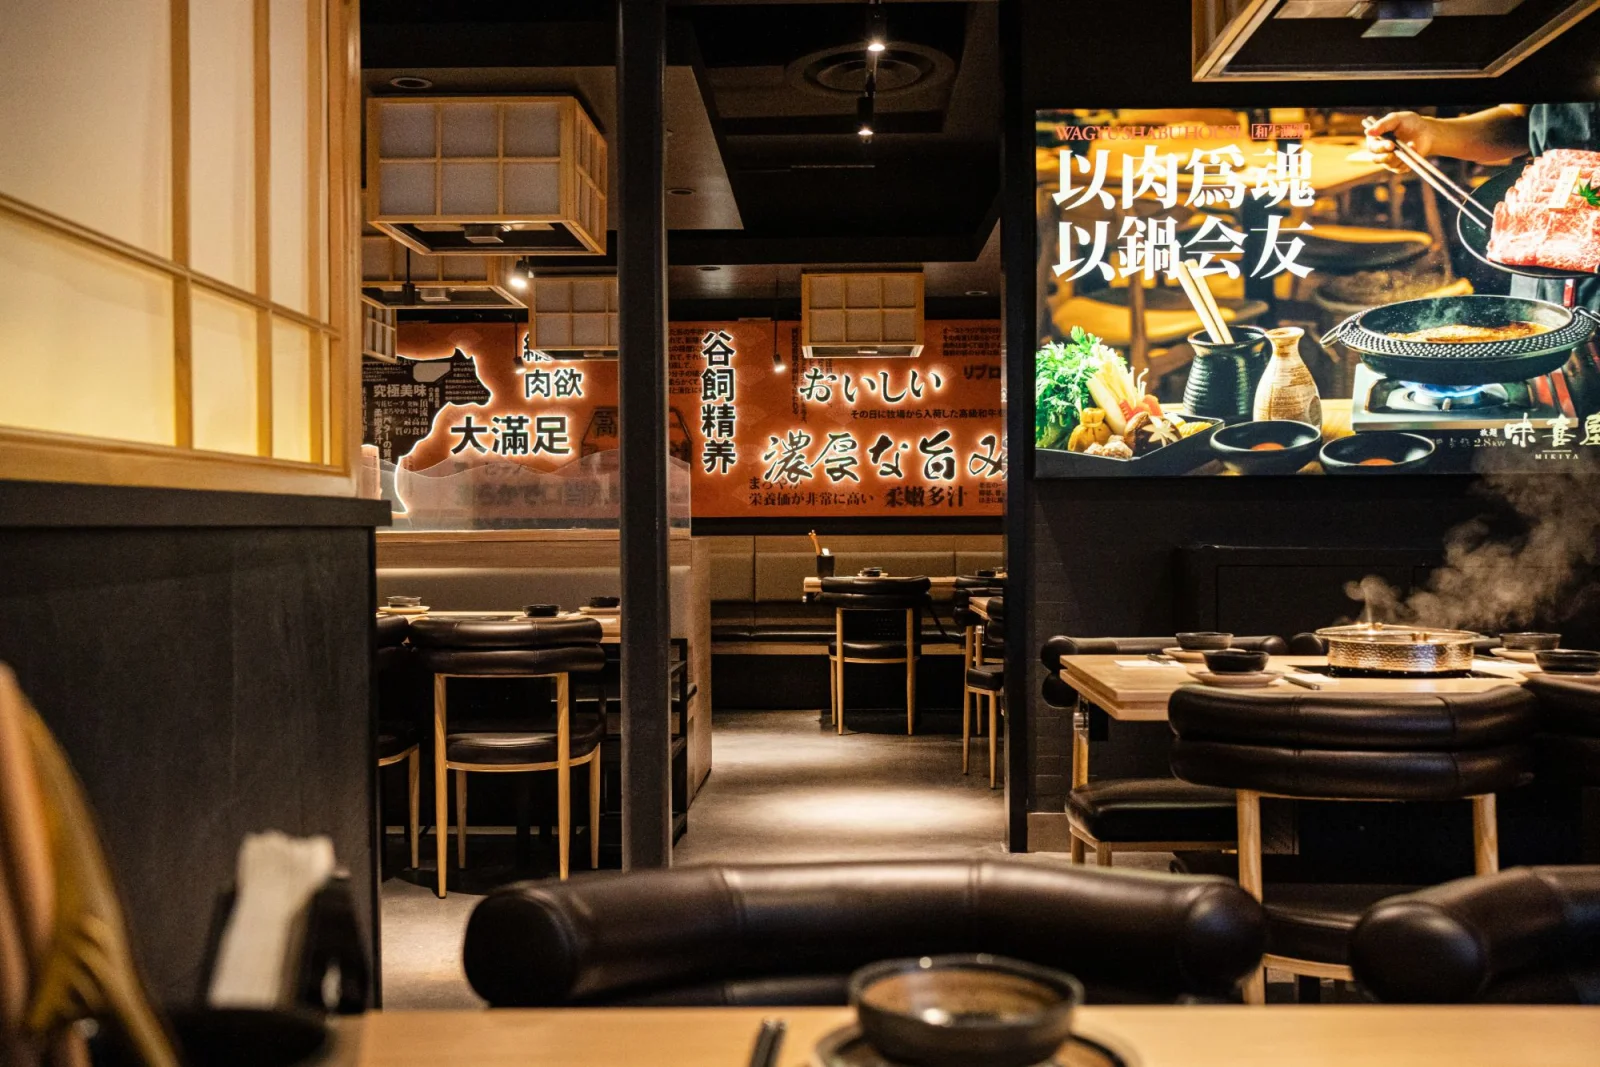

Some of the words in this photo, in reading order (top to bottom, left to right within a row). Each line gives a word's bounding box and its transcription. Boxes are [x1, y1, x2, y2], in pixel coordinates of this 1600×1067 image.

[1055, 126, 1120, 141] WAGYU
[1052, 215, 1315, 282] 以鍋会友
[373, 383, 427, 398] 究極美味
[525, 369, 583, 398] 肉欲
[800, 368, 941, 402] おいしい
[884, 485, 968, 508] 柔嫩多汁
